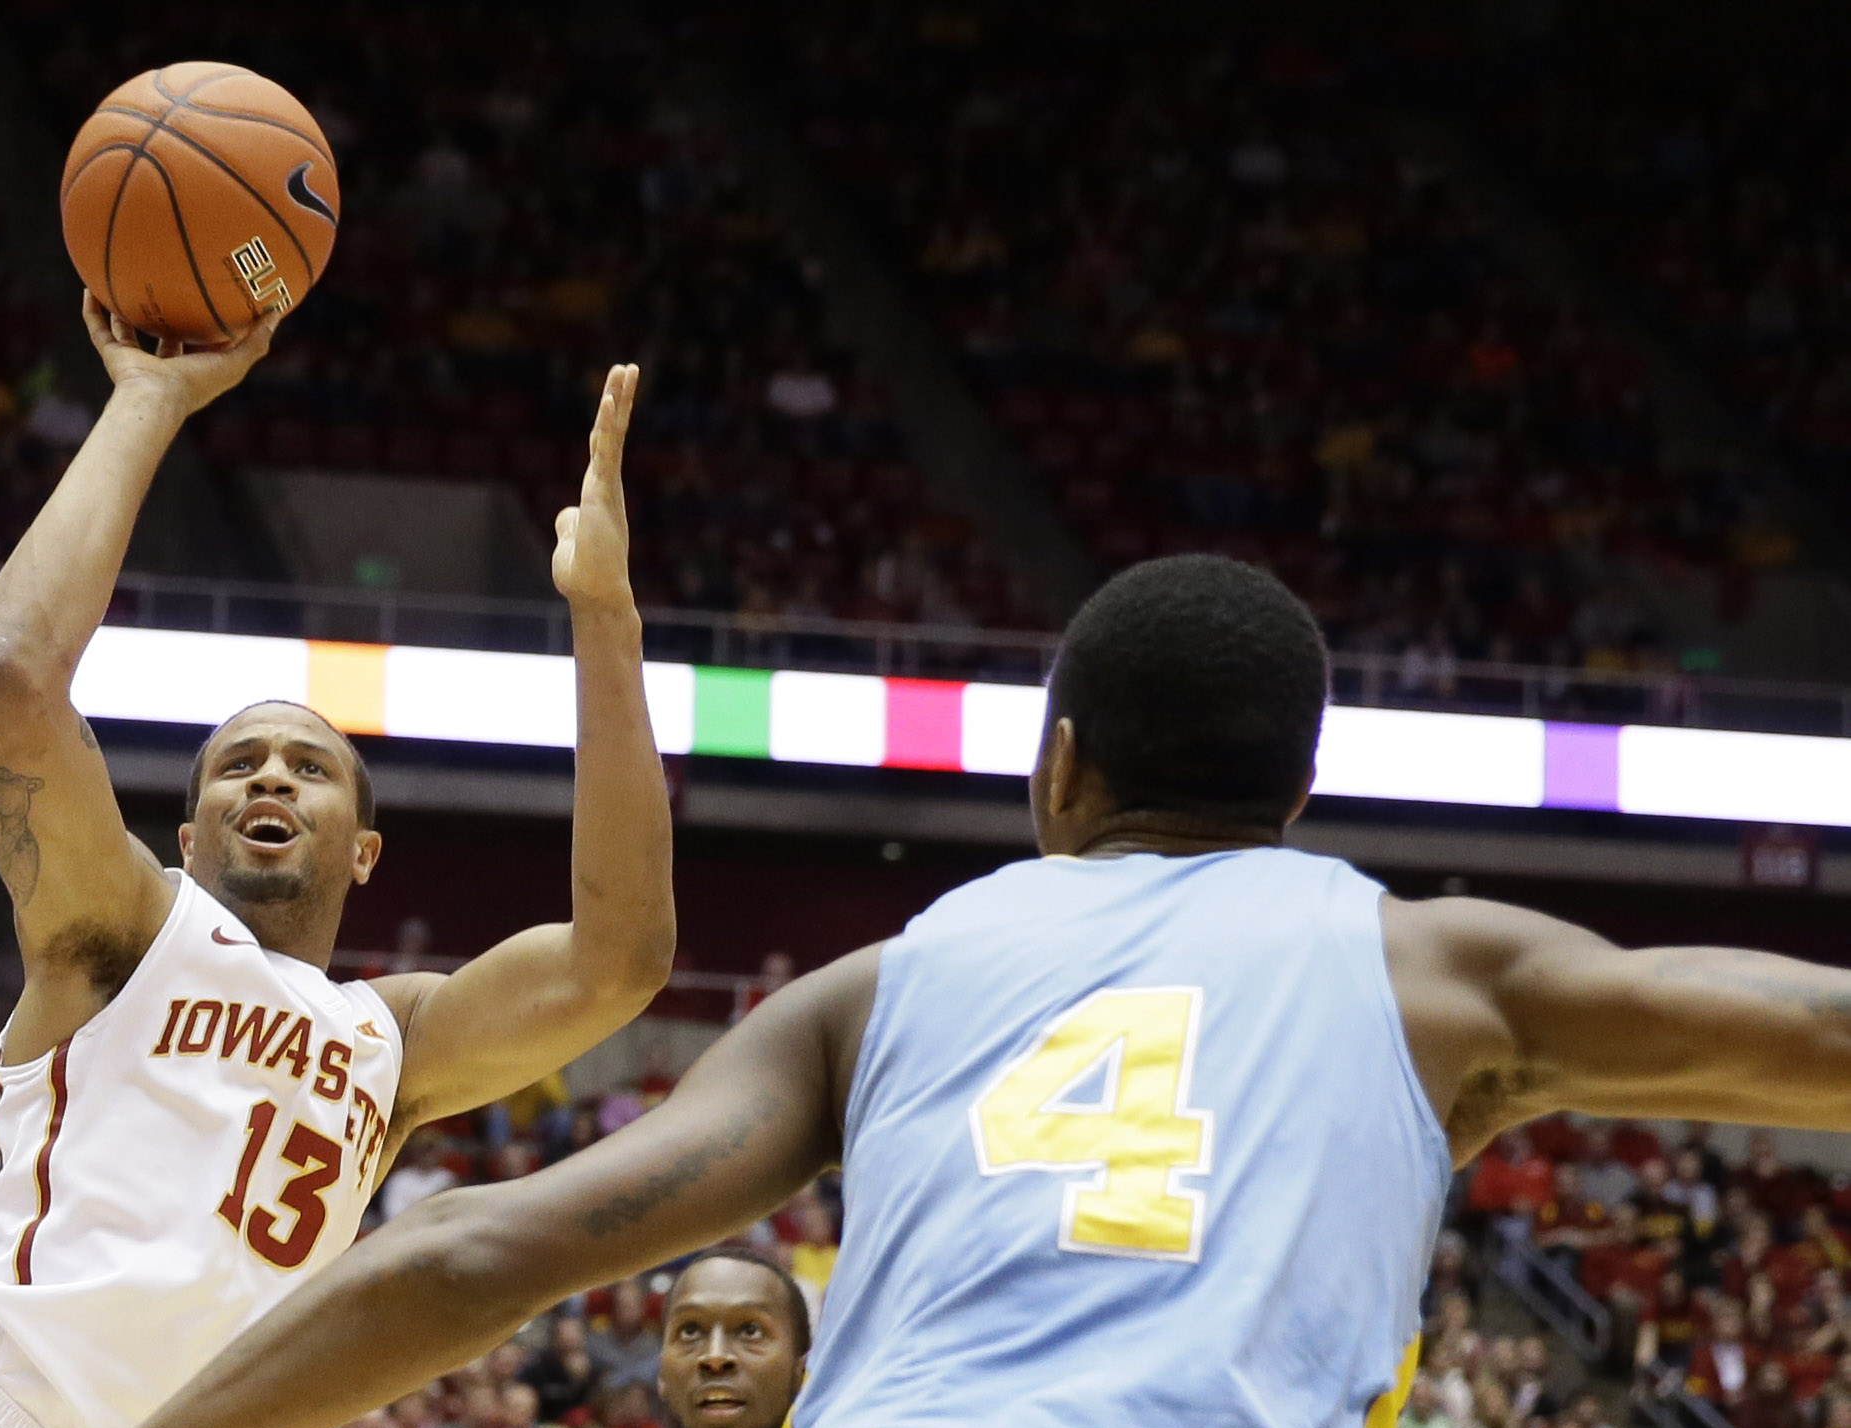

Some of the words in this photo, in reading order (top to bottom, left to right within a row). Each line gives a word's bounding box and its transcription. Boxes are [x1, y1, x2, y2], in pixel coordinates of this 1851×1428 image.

[148, 998, 314, 1081] IOWA
[967, 984, 1215, 1264] 4
[213, 1097, 344, 1272] 13
